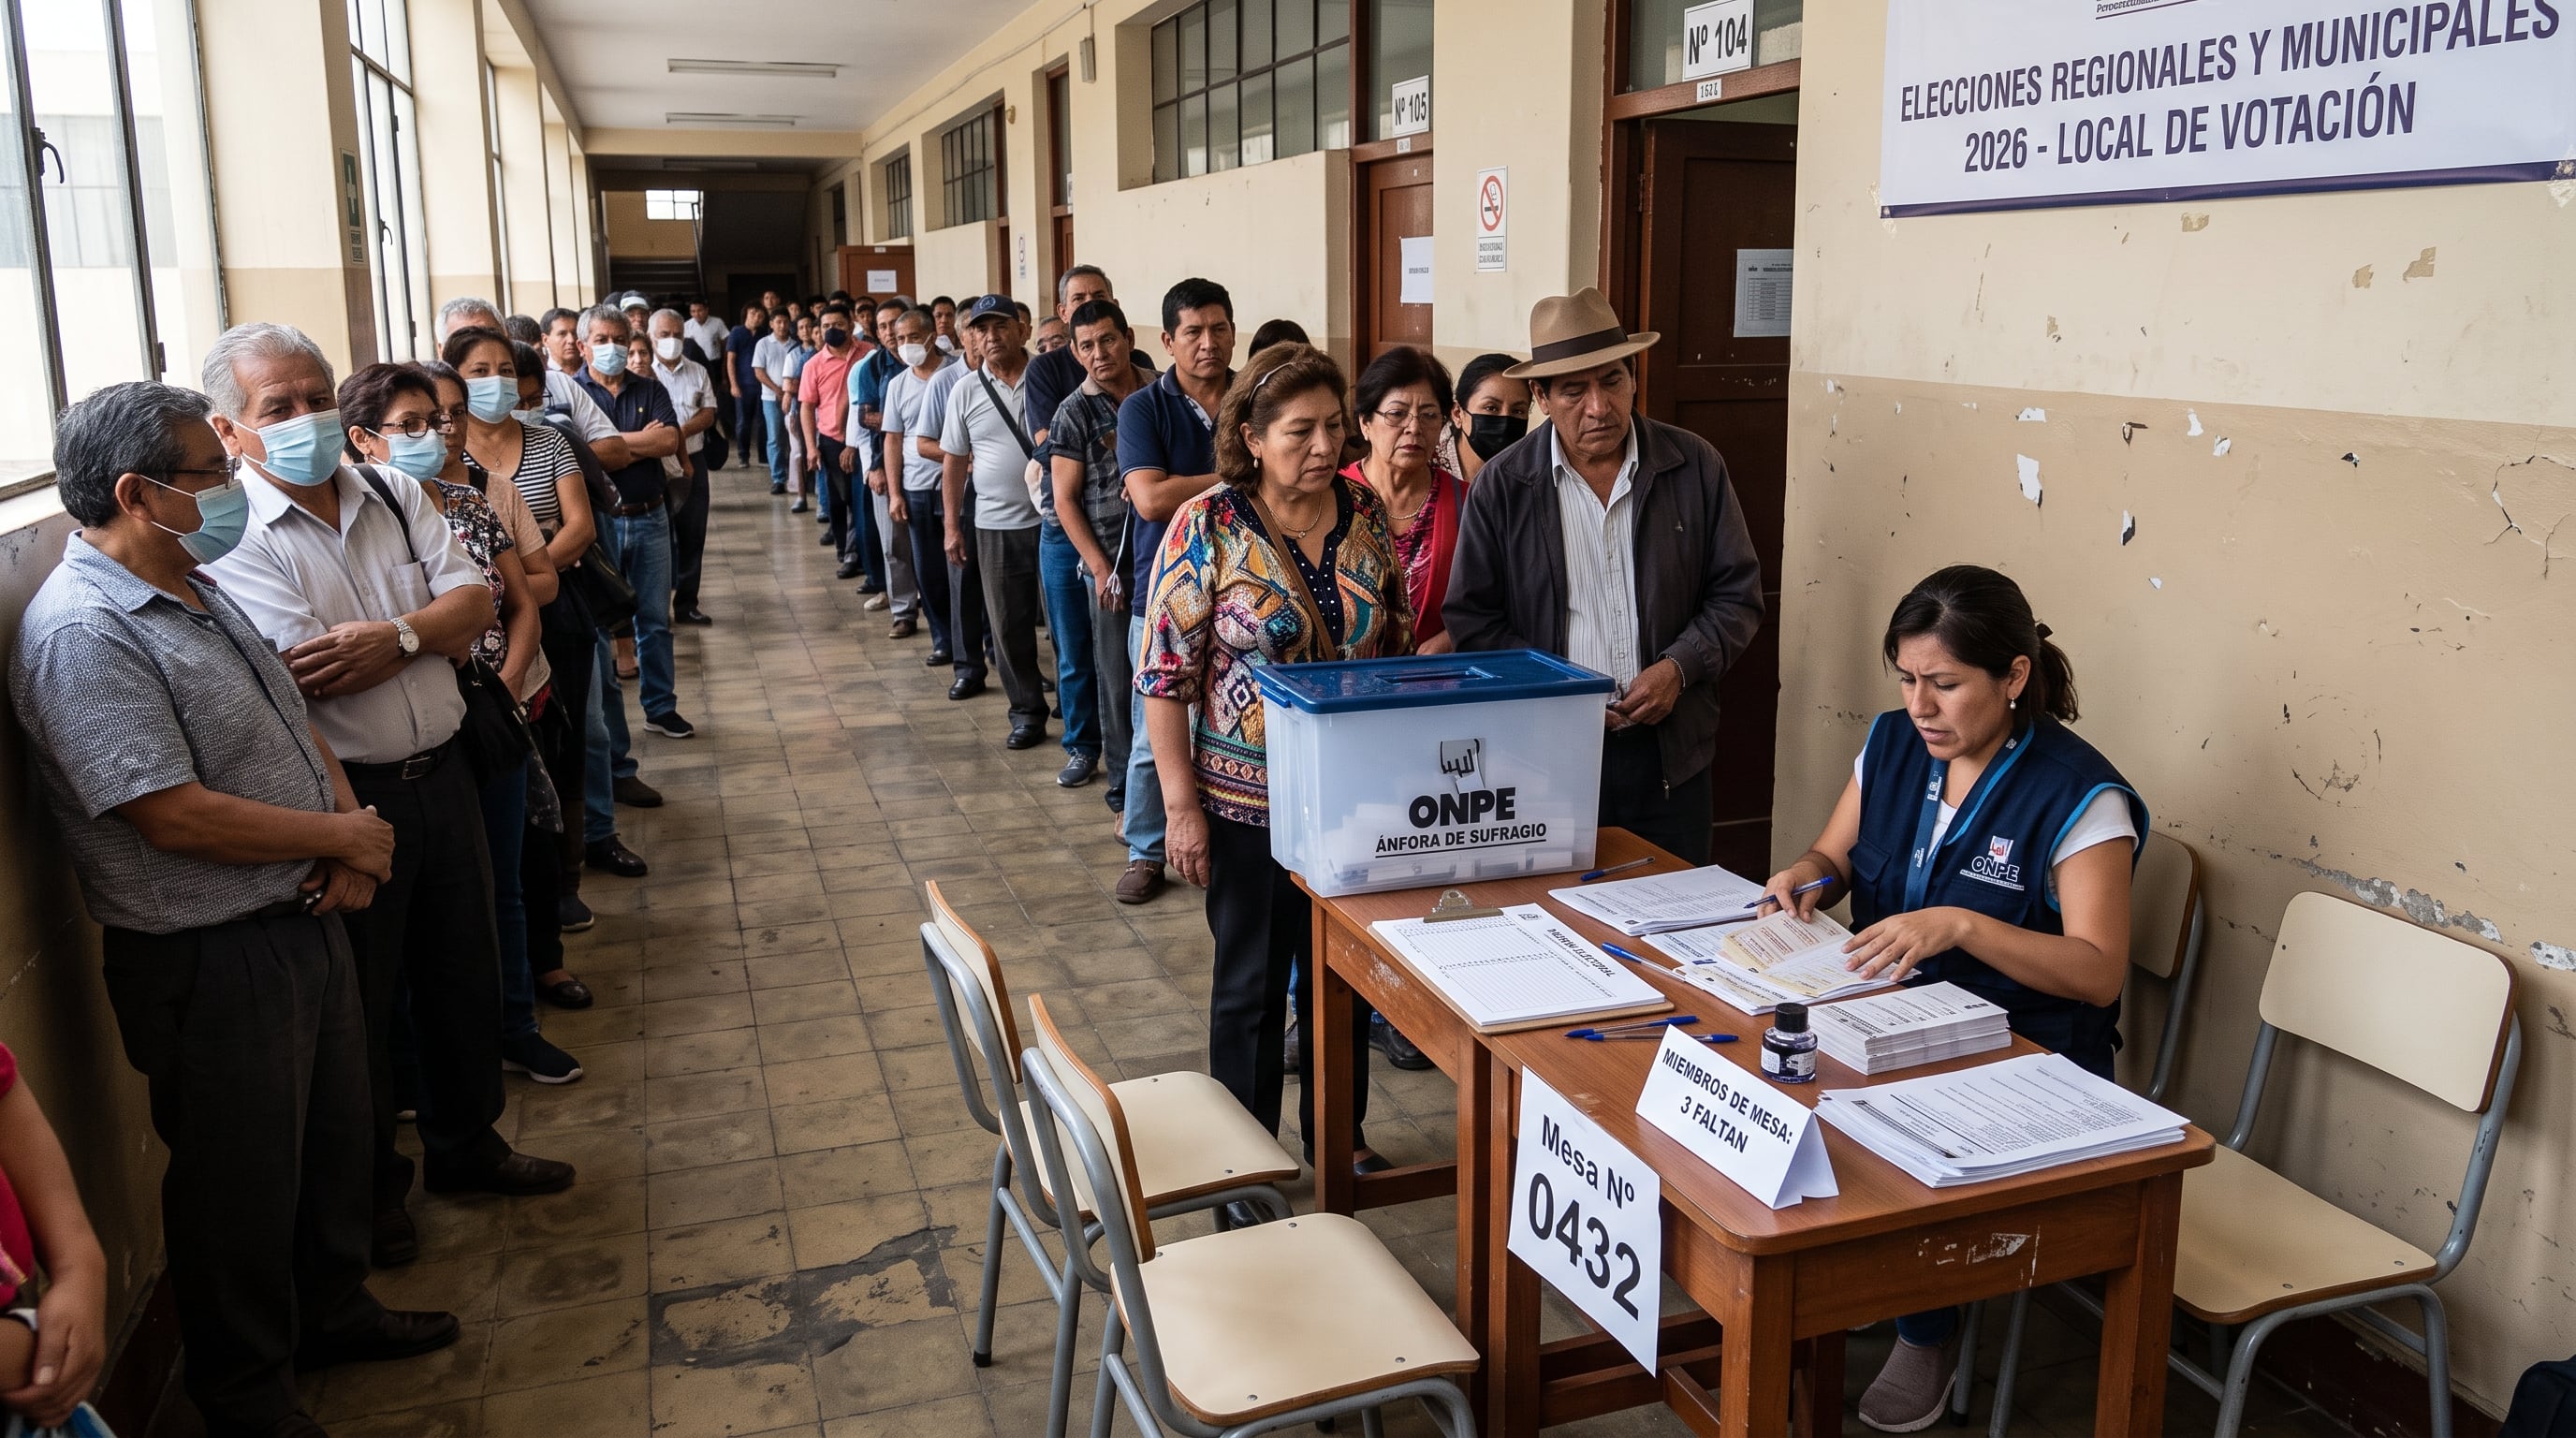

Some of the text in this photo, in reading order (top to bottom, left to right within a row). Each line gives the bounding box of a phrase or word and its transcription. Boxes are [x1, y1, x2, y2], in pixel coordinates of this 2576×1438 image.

[1689, 13, 1748, 66] Nº 104
[1900, 0, 2560, 123] ELECCIONES REGIONALES Y MUNICIPALES
[1395, 92, 1427, 125] Nº 105
[1964, 71, 2417, 173] 2026 - LOCAL DE VOTACIÓN
[1408, 786, 1516, 829] ONPE
[1376, 822, 1547, 853] ÁNFORA DE SUFRAGIO
[1971, 856, 2020, 883] ONPE
[1662, 1047, 1730, 1101] MIEMBROS
[1730, 1091, 1749, 1116] DE
[1749, 1104, 1793, 1145] MESA:
[1680, 1095, 1749, 1153] 3 FALTAN
[1542, 1114, 1635, 1210] Mesa Nº
[1529, 1172, 1641, 1322] 0432
